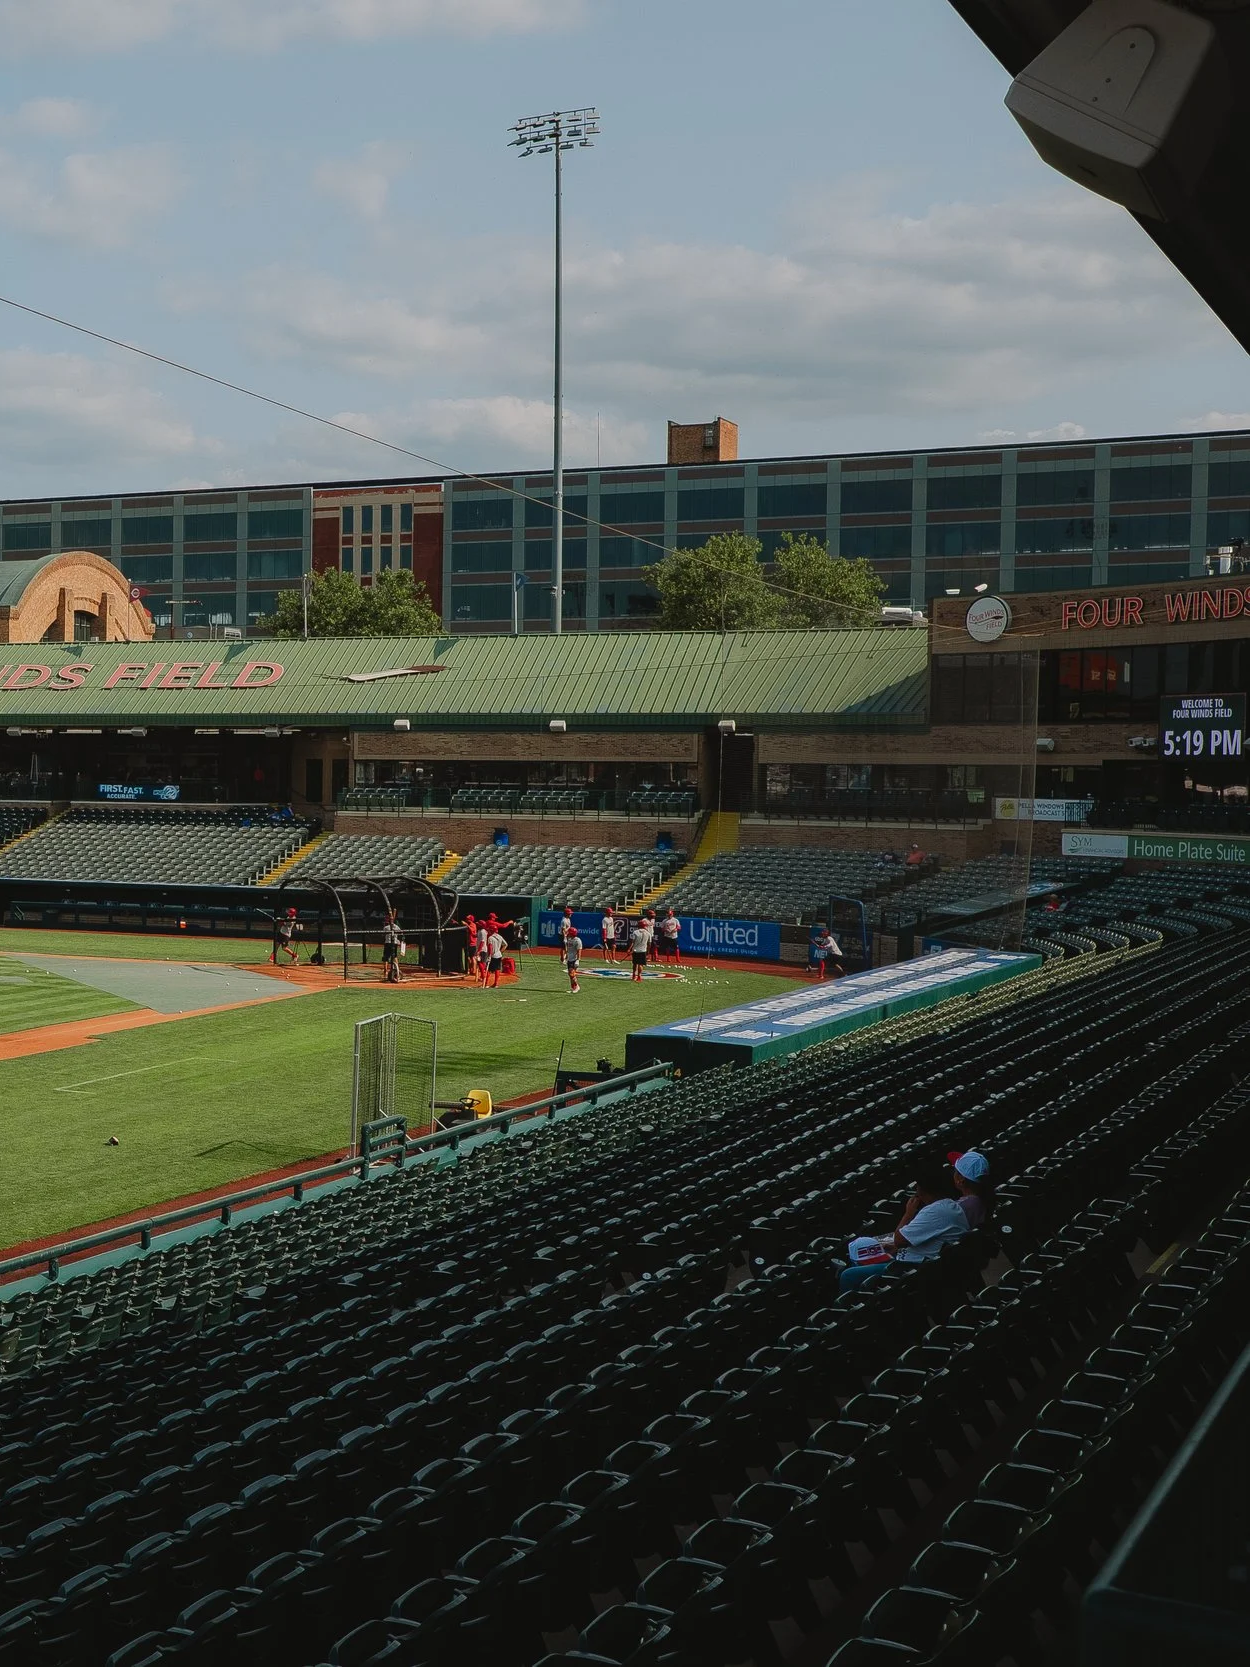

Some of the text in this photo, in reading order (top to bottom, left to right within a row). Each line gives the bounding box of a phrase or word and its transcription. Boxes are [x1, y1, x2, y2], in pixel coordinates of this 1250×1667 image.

[968, 608, 1005, 622] FOUR WINDS
[1061, 596, 1144, 630] FOUR
[985, 620, 1003, 630] FIELD
[103, 661, 285, 690] FIELD
[1181, 698, 1224, 709] WELCOME TO
[1172, 708, 1233, 719] FOUR WINDS FIELD
[1163, 729, 1242, 756] 5:19 PM
[1070, 836, 1092, 848] SYM
[1134, 839, 1246, 862] Home Plate Suite
[689, 919, 758, 947] United
